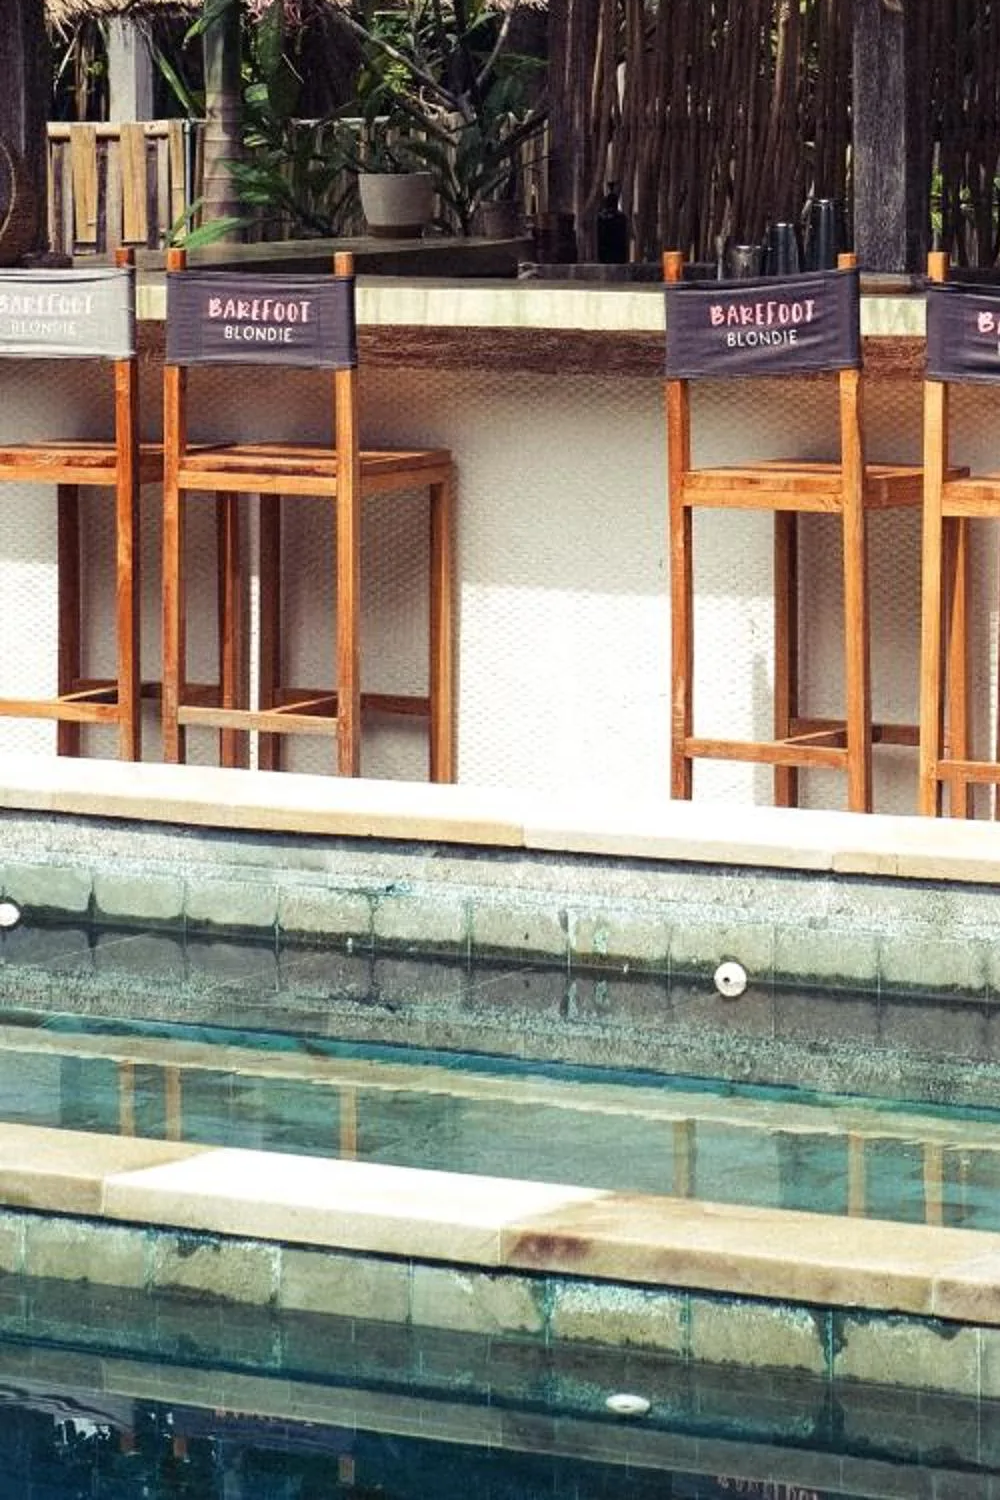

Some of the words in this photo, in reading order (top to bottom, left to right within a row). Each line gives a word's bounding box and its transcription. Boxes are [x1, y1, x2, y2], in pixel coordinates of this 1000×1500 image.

[0, 293, 95, 315] BAREFOOT
[208, 298, 311, 322] BAREFOOT
[710, 299, 815, 326] BAREFOOT
[10, 320, 77, 336] BLONDIE
[224, 325, 293, 343] BLONDIE
[727, 329, 799, 347] BLONDIE
